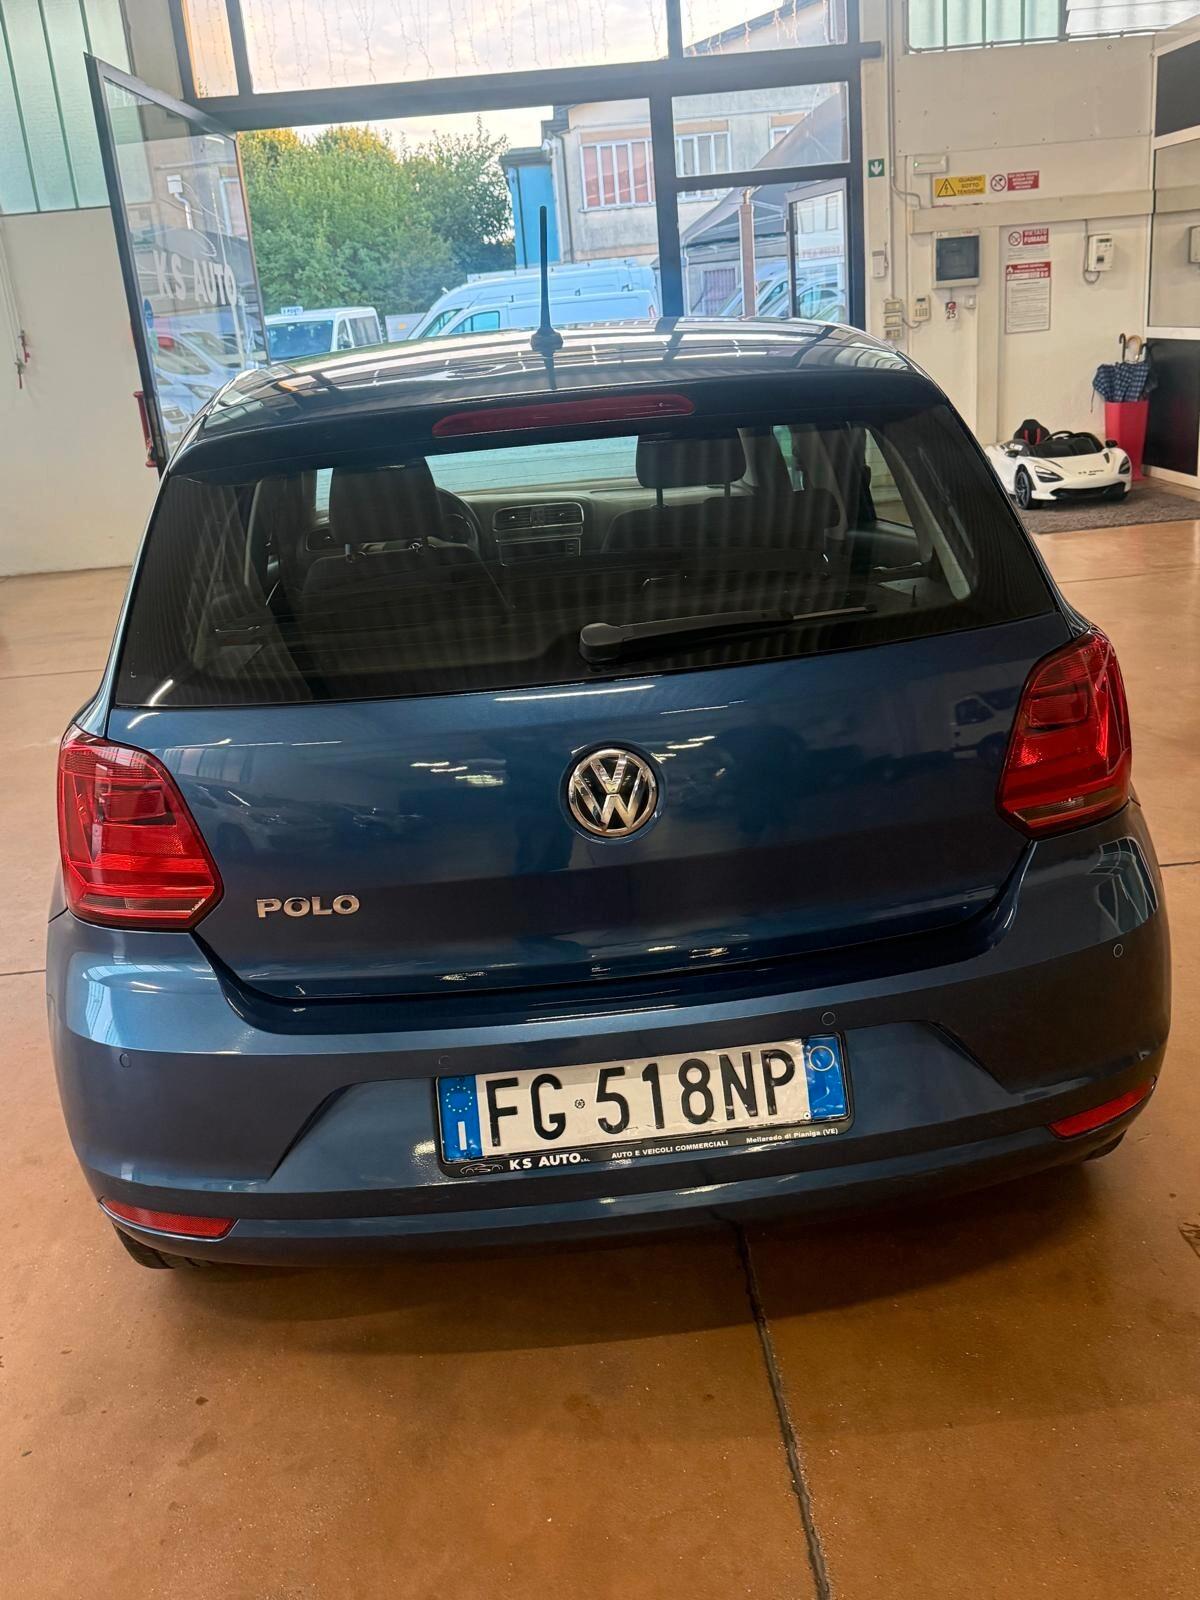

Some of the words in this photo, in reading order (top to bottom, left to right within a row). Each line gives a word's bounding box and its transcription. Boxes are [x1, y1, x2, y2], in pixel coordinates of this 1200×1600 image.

[153, 250, 186, 301] KS
[193, 258, 237, 305] AUTO
[256, 894, 360, 918] POLO
[784, 1132, 792, 1140] di
[794, 1129, 821, 1139] Pianiga
[823, 1127, 838, 1137] (VE)
[611, 1151, 633, 1159] AUTO
[642, 1145, 673, 1155] VEICOLI
[675, 1140, 729, 1152] COMMERCIALI
[509, 1158, 532, 1171] KS
[539, 1153, 581, 1168] AUTO
